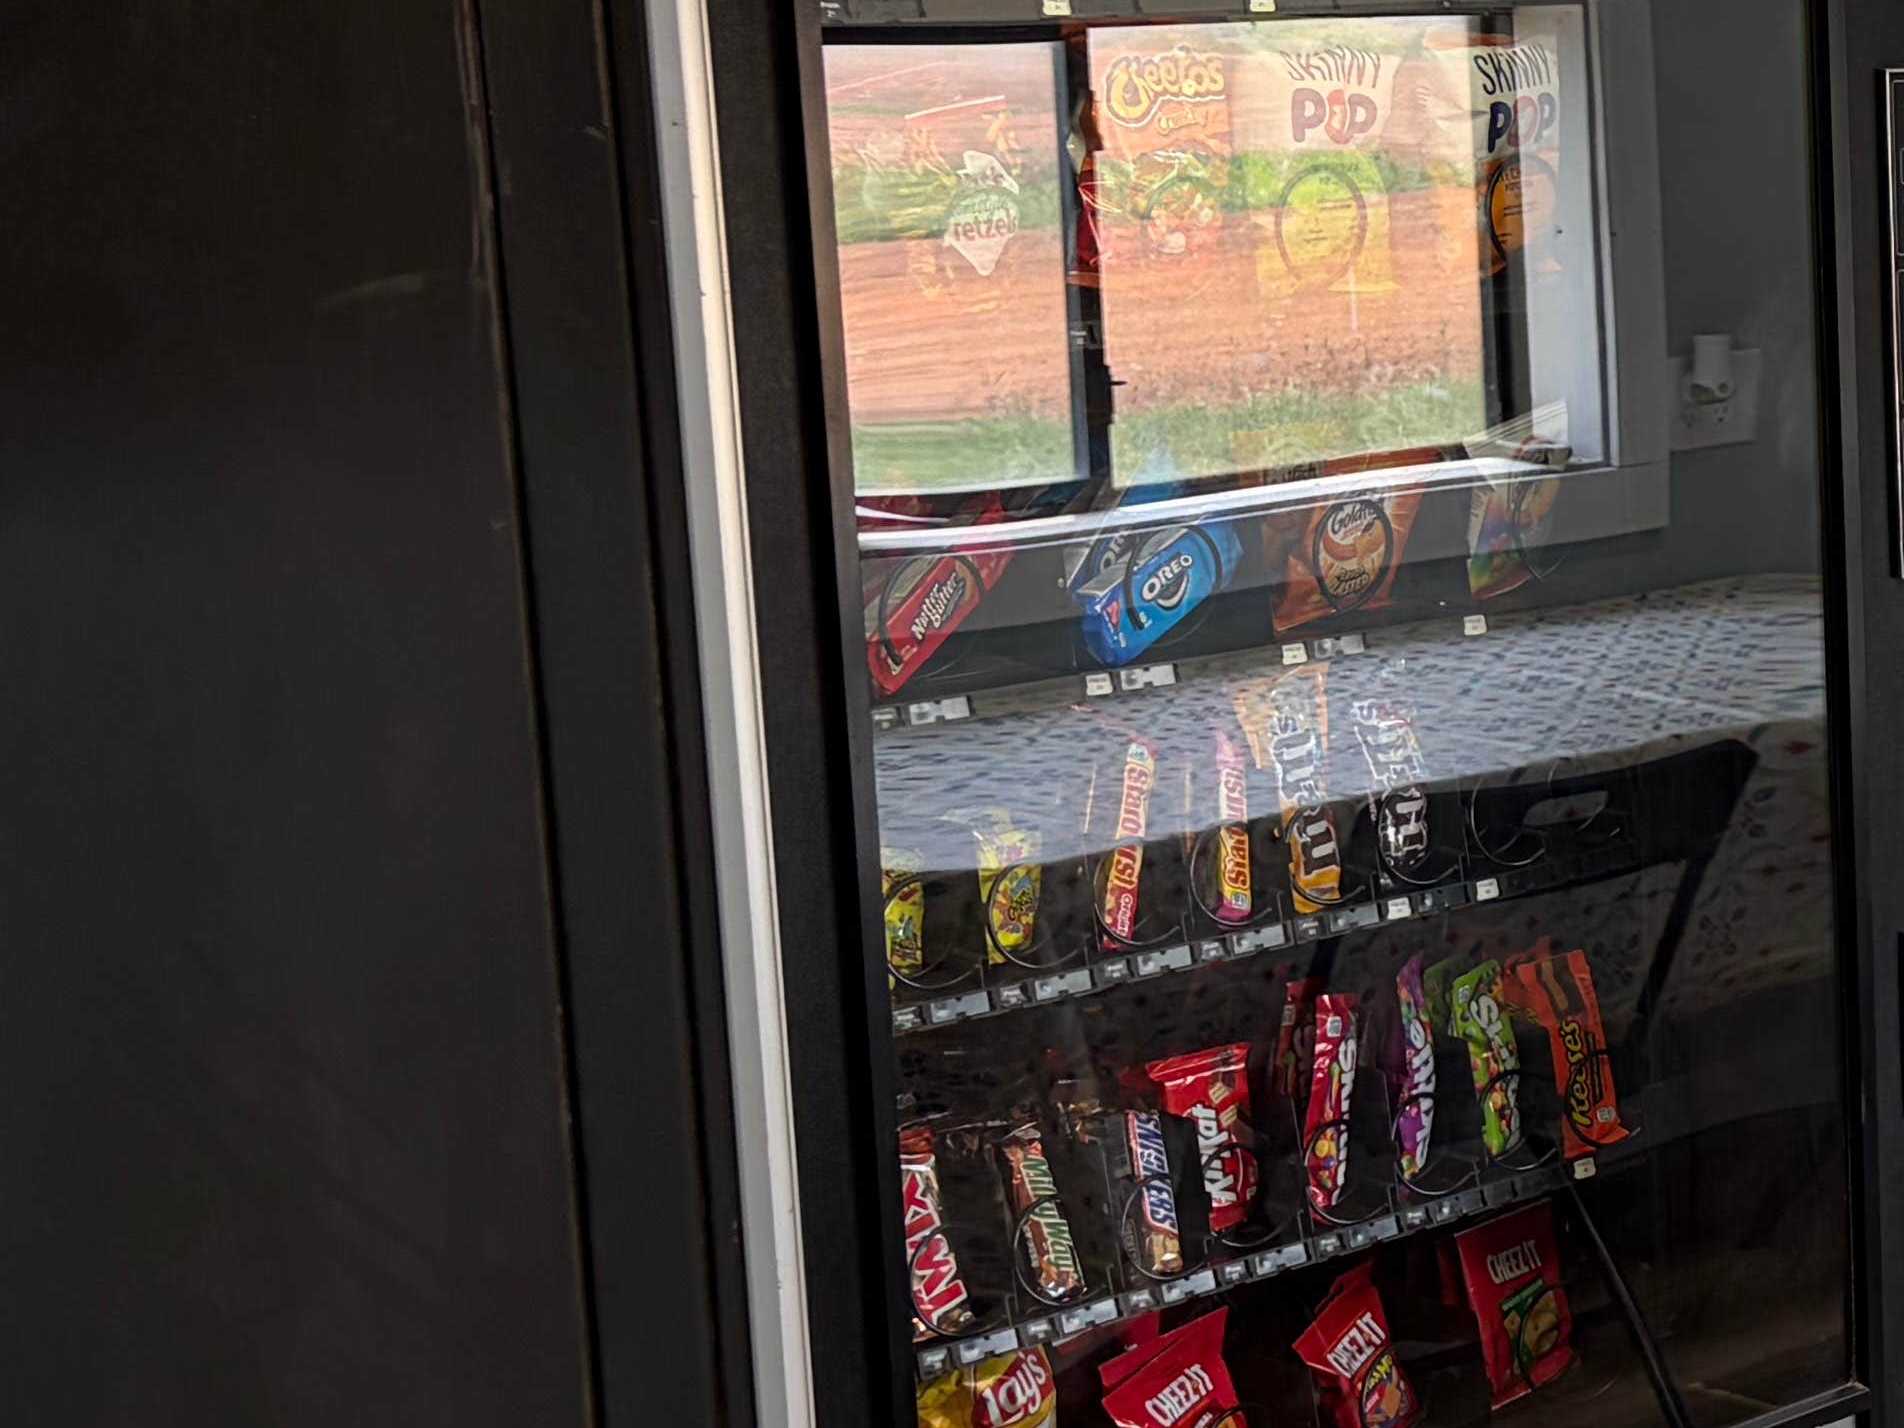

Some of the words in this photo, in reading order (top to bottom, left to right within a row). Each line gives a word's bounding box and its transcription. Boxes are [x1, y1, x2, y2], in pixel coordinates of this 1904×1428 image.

[1290, 87, 1378, 145] POP
[1486, 92, 1558, 154] POP
[1142, 554, 1193, 601] OREO
[903, 1172, 968, 1323] TWIX
